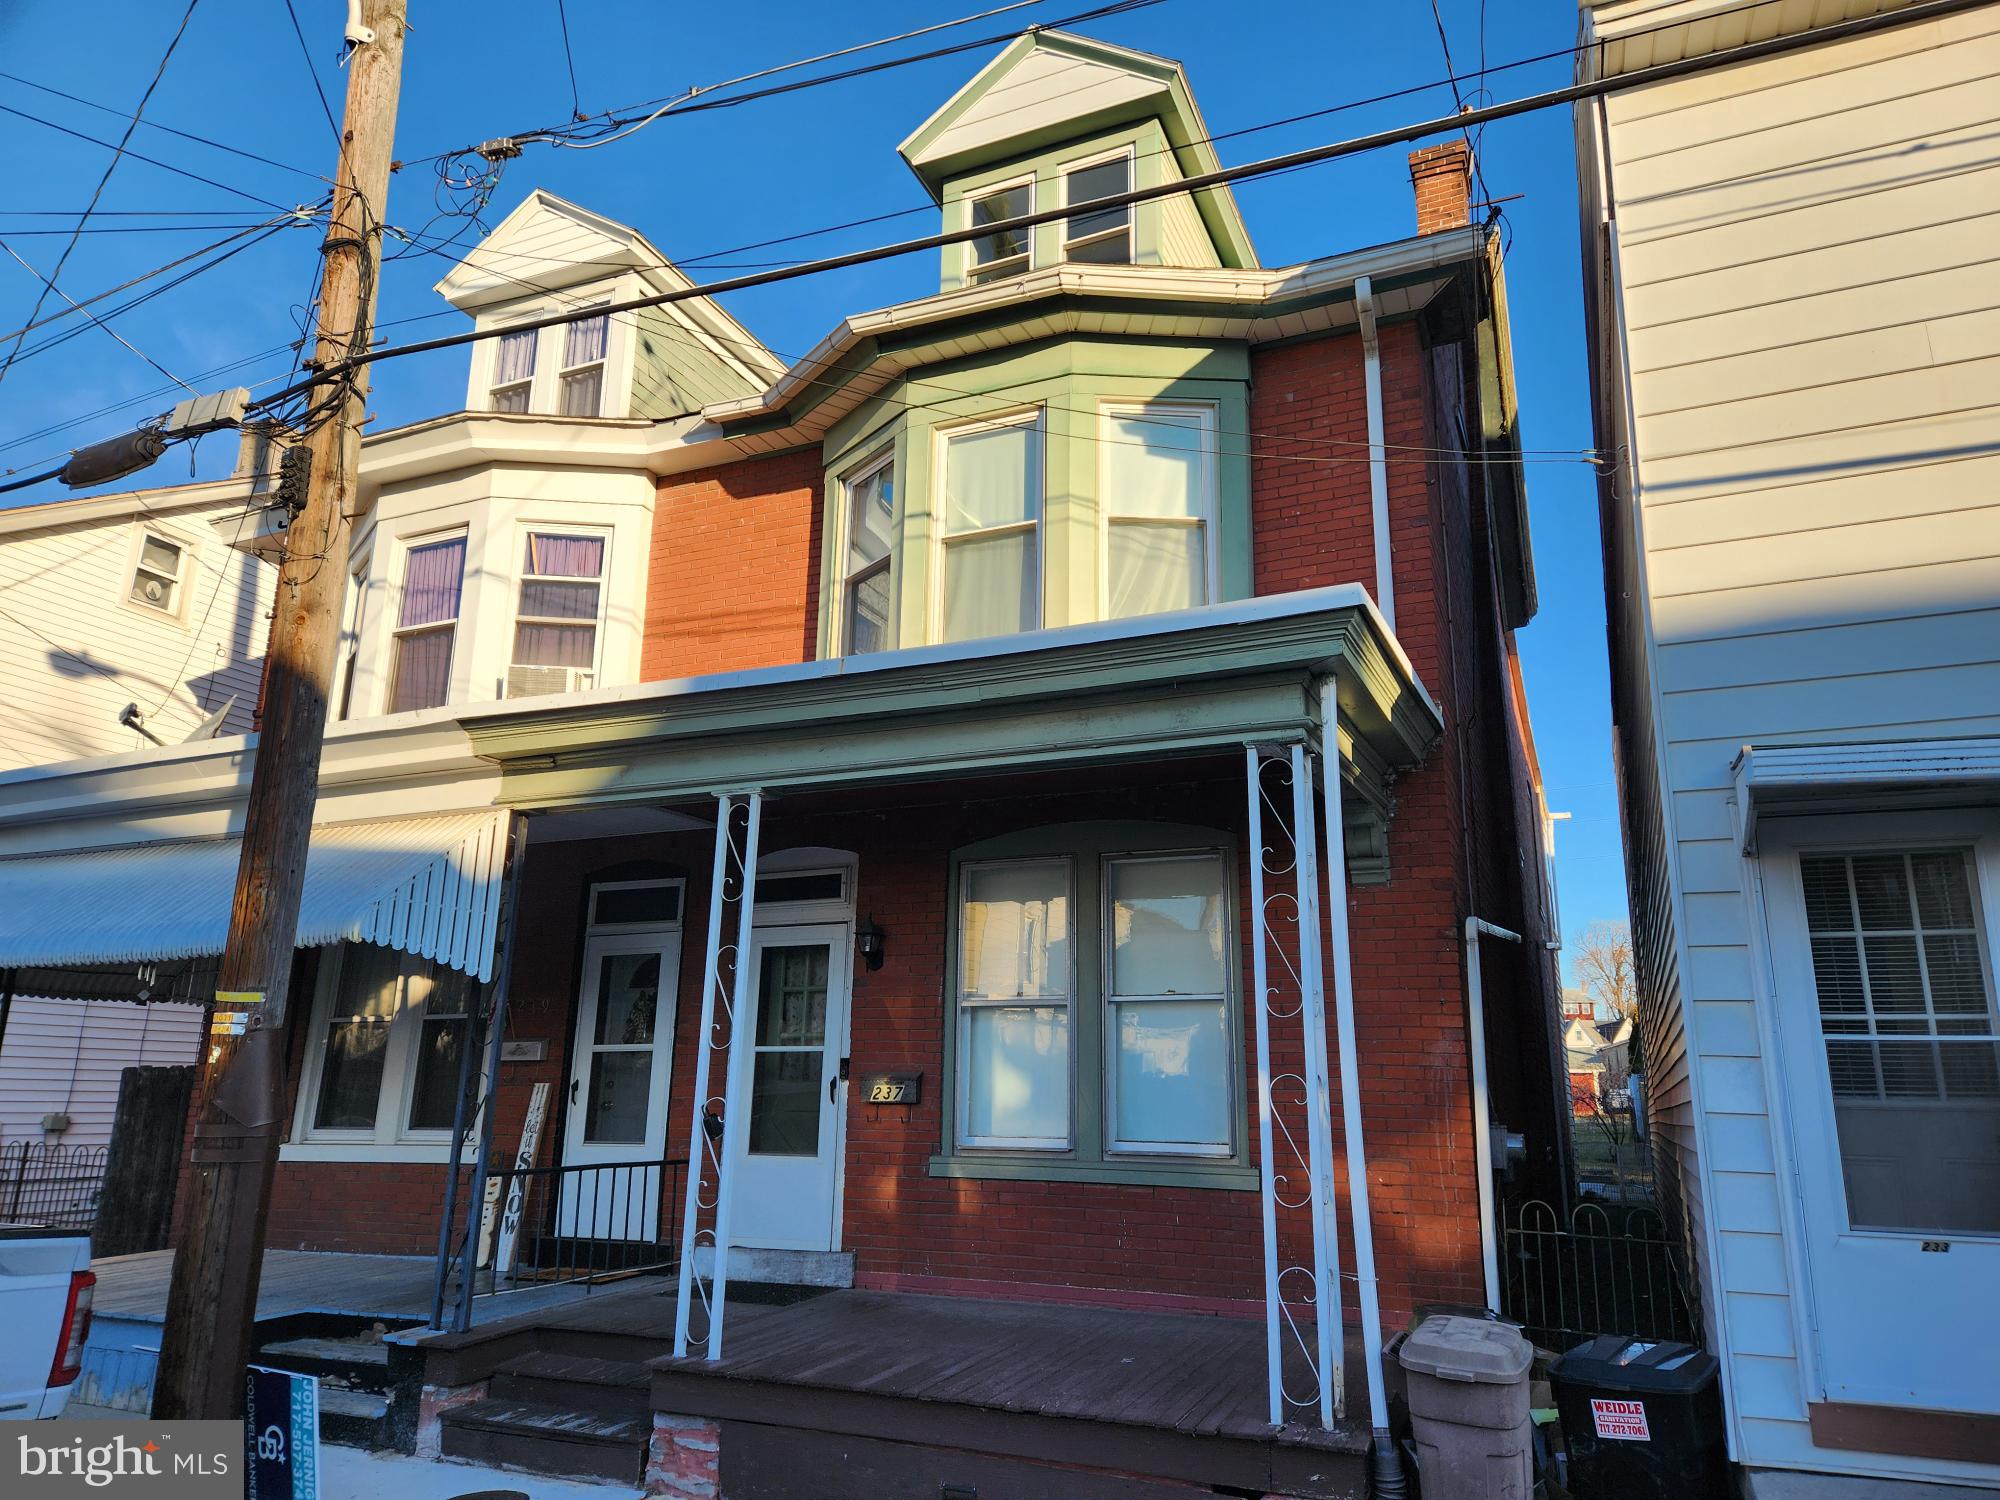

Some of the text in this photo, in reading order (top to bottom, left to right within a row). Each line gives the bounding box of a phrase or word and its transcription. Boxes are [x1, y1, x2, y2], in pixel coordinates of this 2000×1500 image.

[872, 1086, 904, 1100] 237
[1922, 1242, 1949, 1252] 233
[247, 1375, 257, 1447] COLDWELL
[302, 1379, 313, 1431] JOHN
[1593, 1401, 1642, 1414] WEIDLE
[1599, 1415, 1641, 1424] SANITATION
[1599, 1424, 1646, 1435] 717-272-7061
